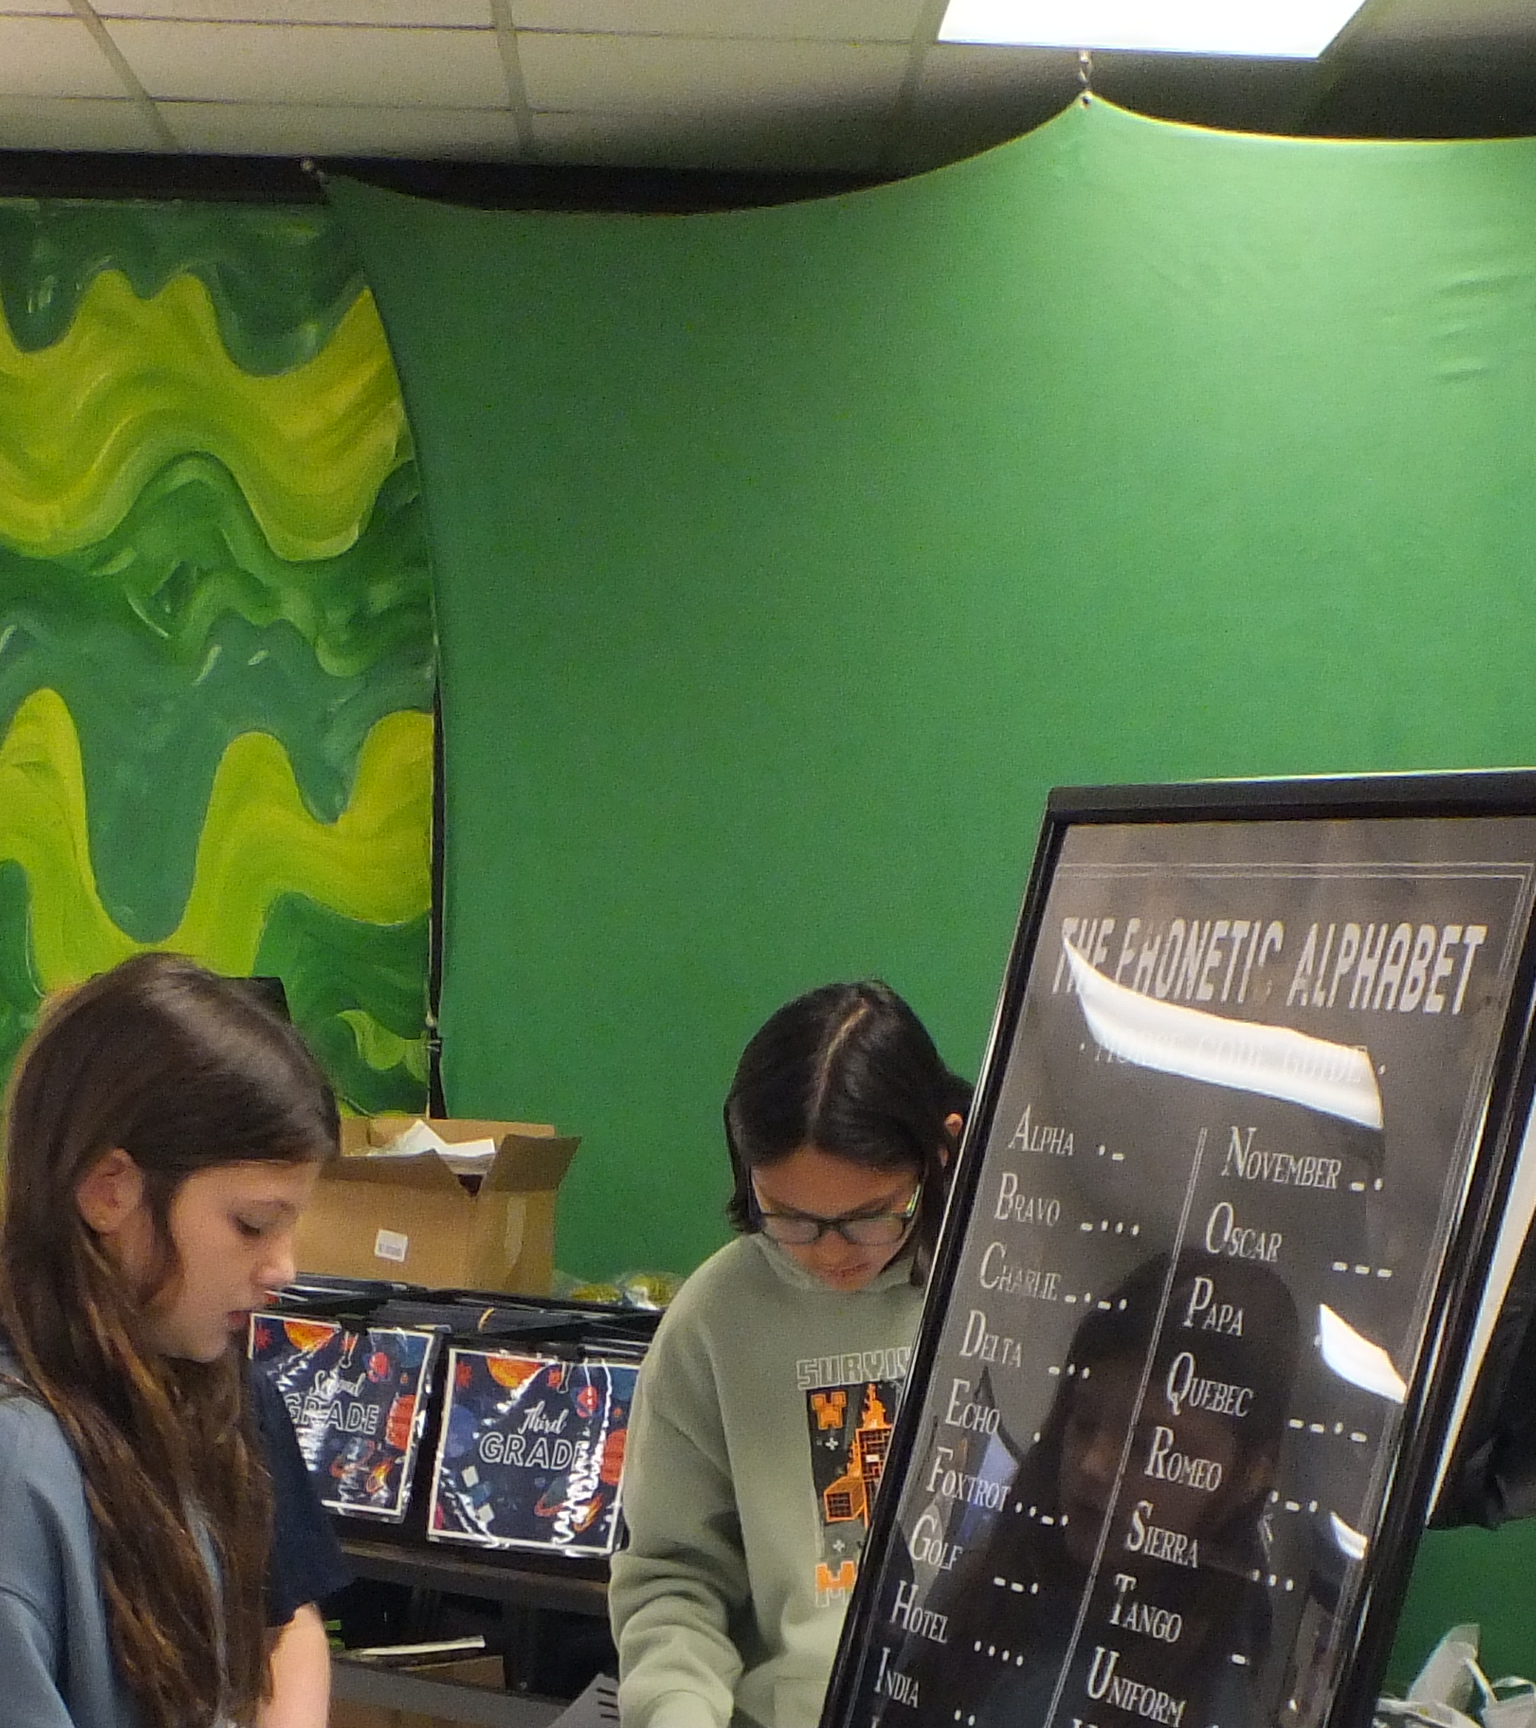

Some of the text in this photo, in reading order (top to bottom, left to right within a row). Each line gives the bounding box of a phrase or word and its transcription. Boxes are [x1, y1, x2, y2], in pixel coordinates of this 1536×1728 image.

[1287, 922, 1488, 1016] ALPHABET
[1008, 1103, 1075, 1157] ALPHA
[1220, 1125, 1342, 1189] NOVEMBER
[994, 1172, 1061, 1227] BRAVO
[1204, 1201, 1283, 1263] OSCAR
[979, 1241, 1062, 1301] CHARLIE
[1182, 1276, 1245, 1337] PAPA
[944, 1377, 1000, 1436] ECHO
[1165, 1351, 1253, 1419] QUEBEC
[518, 1400, 570, 1435] Third
[927, 1446, 1011, 1512] FOXTROT
[1145, 1425, 1223, 1492] ROMEO
[907, 1512, 963, 1572] GOLF
[1126, 1499, 1200, 1569] SIERRA
[889, 1579, 949, 1645] HOTEL
[1107, 1573, 1183, 1644] TANGO
[872, 1646, 921, 1710] INDIA
[1086, 1645, 1187, 1728] UNIFORM
